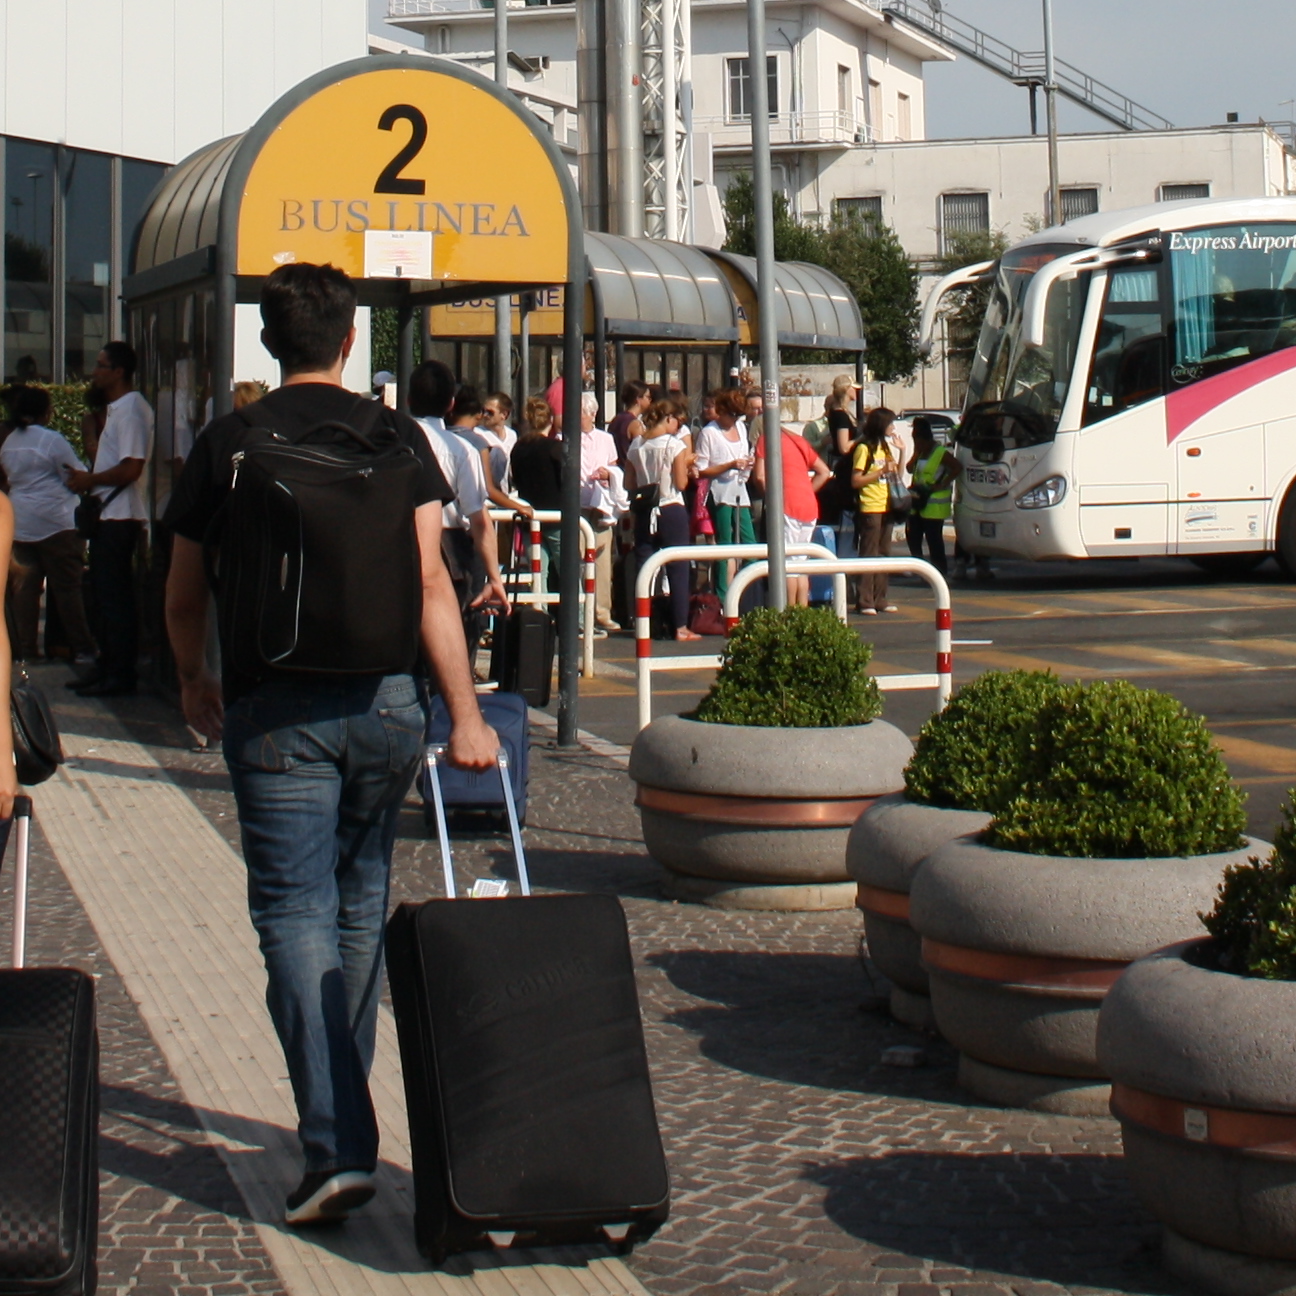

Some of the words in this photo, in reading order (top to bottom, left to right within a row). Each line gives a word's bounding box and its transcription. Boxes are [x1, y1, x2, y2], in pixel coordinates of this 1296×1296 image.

[373, 103, 428, 195] 2
[278, 198, 371, 233] BUS
[384, 200, 531, 237] LINEA
[1169, 233, 1236, 254] Express
